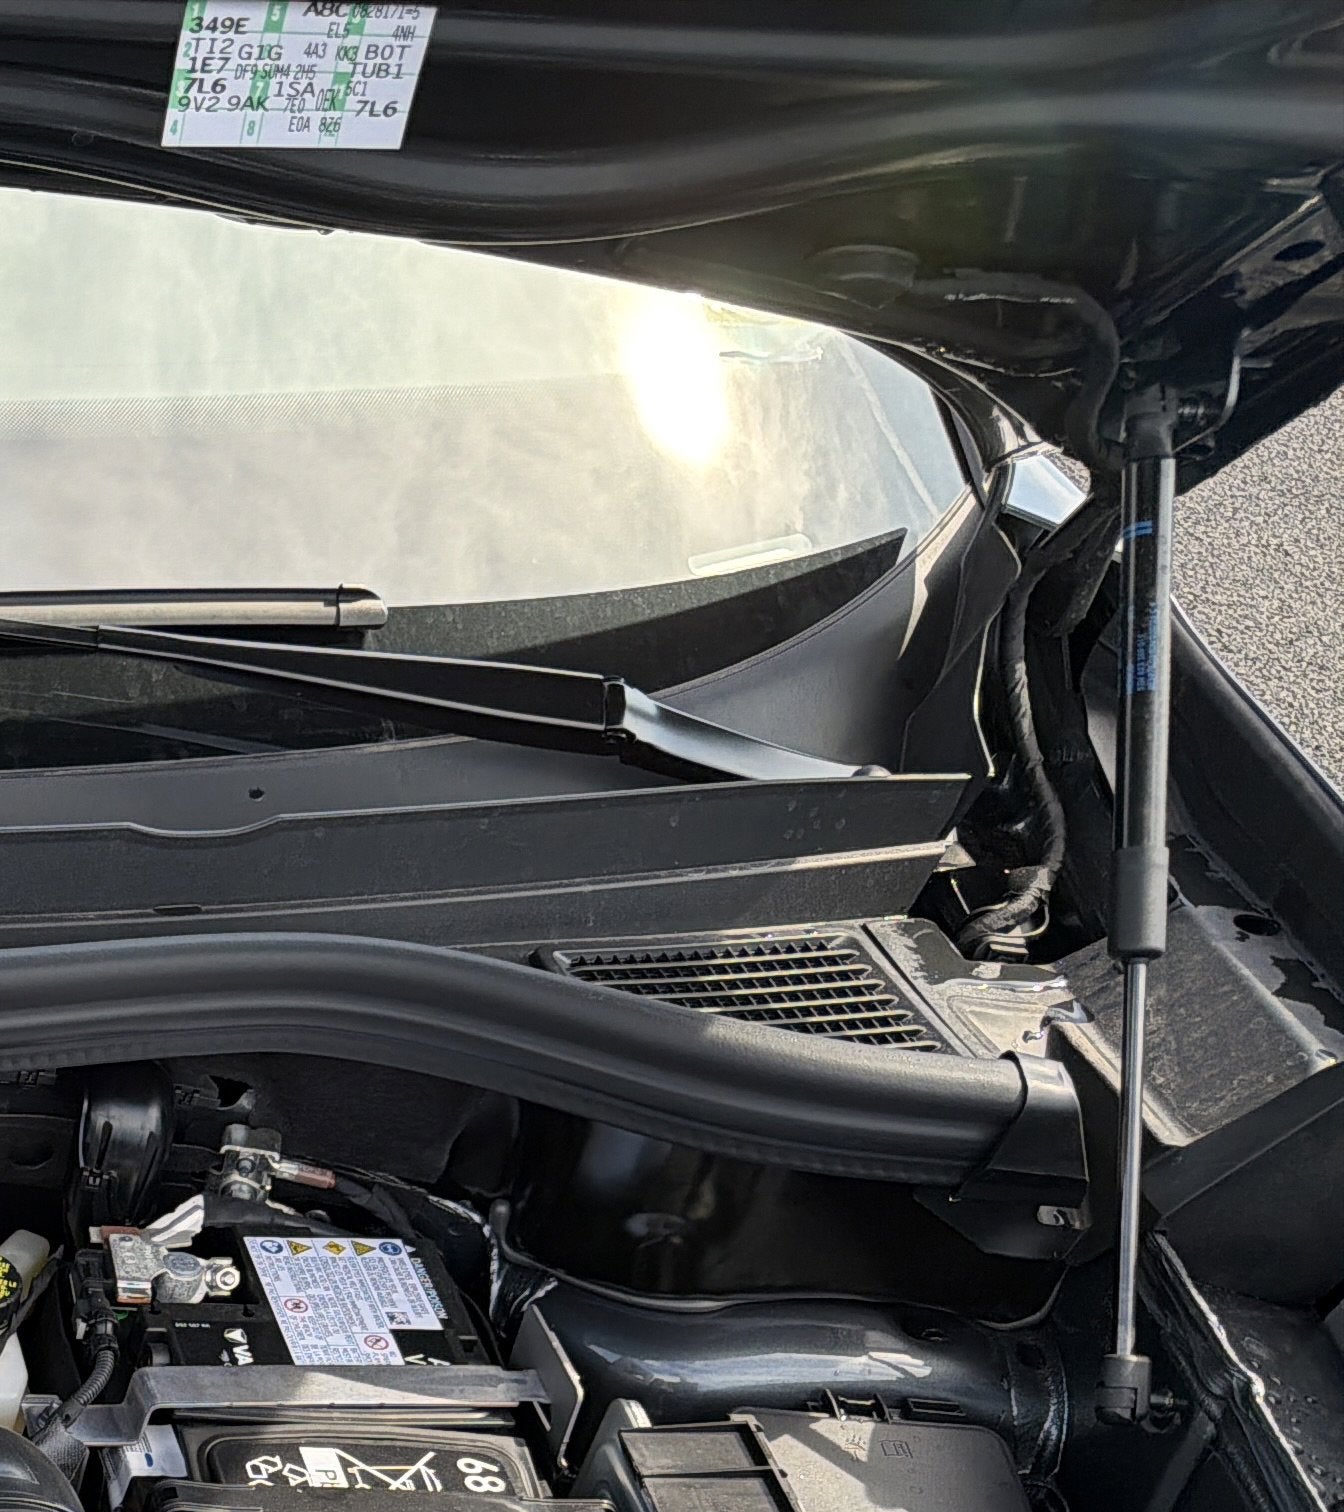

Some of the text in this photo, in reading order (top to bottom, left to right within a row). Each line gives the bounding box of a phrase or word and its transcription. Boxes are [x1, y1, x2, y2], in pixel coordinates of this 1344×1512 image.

[189, 16, 250, 35] 349E
[327, 21, 351, 39] EL5
[392, 25, 416, 42] 4NH
[304, 42, 327, 60] 4A3
[185, 56, 231, 75] 1E7
[348, 62, 403, 80] TUB1
[184, 77, 228, 95] 7L6
[273, 81, 315, 98] 1SA
[178, 95, 270, 113] 9V2 9AK
[355, 100, 398, 118] 7L6
[246, 120, 256, 137] 8
